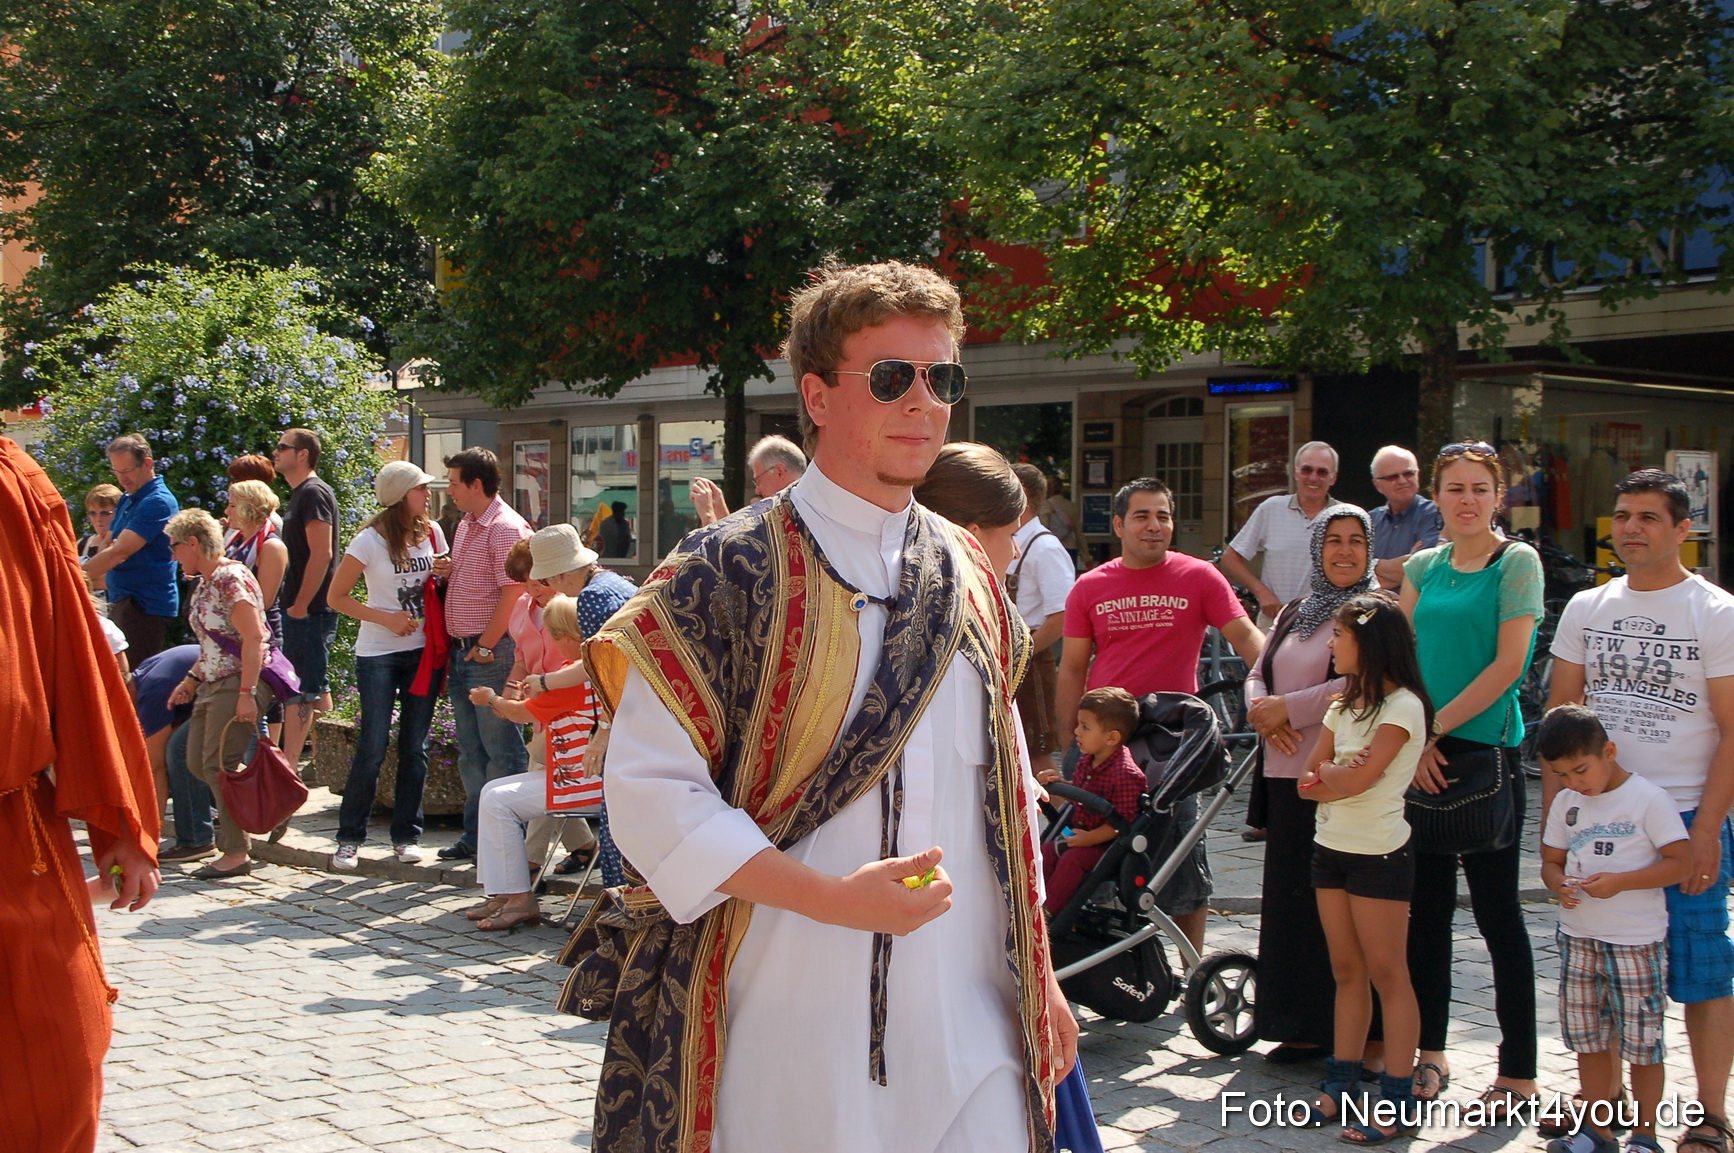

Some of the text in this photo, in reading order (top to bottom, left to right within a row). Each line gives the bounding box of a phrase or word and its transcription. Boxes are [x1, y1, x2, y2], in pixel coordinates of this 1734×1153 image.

[1095, 595, 1189, 615] DENIM BRAND
[1119, 609, 1161, 623] VINTAGE
[1624, 621, 1653, 632] 1973
[1584, 634, 1700, 661] NEW YORK
[1596, 652, 1672, 685] 1973
[1611, 678, 1698, 706] ANGELES
[1629, 709, 1676, 721] MENSWEAR
[1643, 702, 1670, 713] STYLE
[1649, 729, 1671, 738] 1973
[1594, 841, 1614, 856] 98
[1112, 976, 1146, 1002] Safety
